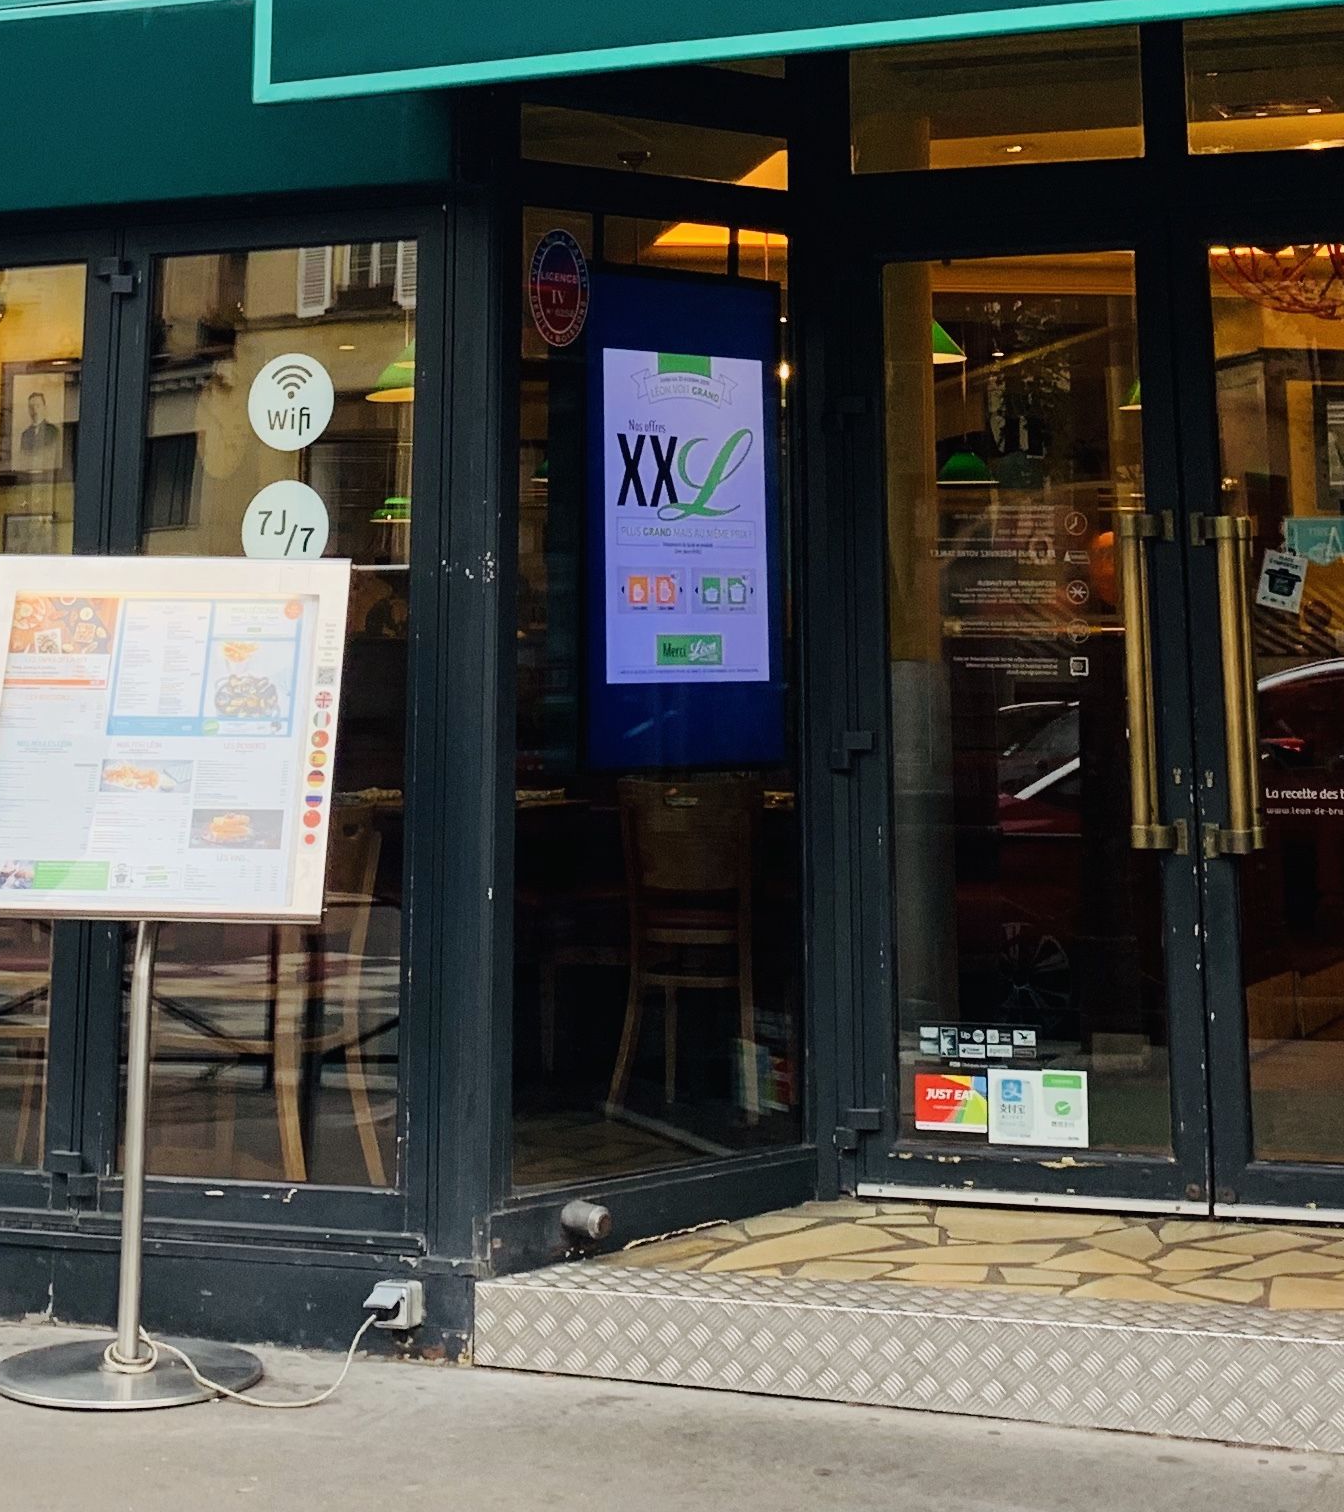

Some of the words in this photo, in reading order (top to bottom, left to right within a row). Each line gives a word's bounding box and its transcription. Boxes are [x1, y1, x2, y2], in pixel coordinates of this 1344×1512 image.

[540, 272, 578, 285] LICENCE
[692, 386, 720, 402] GRAND
[267, 407, 311, 436] Wifi
[628, 419, 643, 432] Nos
[644, 419, 666, 434] offres
[617, 428, 753, 521] XXL
[258, 509, 315, 557] 7J/7
[643, 527, 672, 537] GRAND
[663, 643, 686, 657] Merci
[1265, 788, 1279, 800] La
[1281, 788, 1317, 800] recette
[1319, 789, 1338, 800] des
[926, 1088, 954, 1100] JUST
[955, 1089, 974, 1101] EAT
